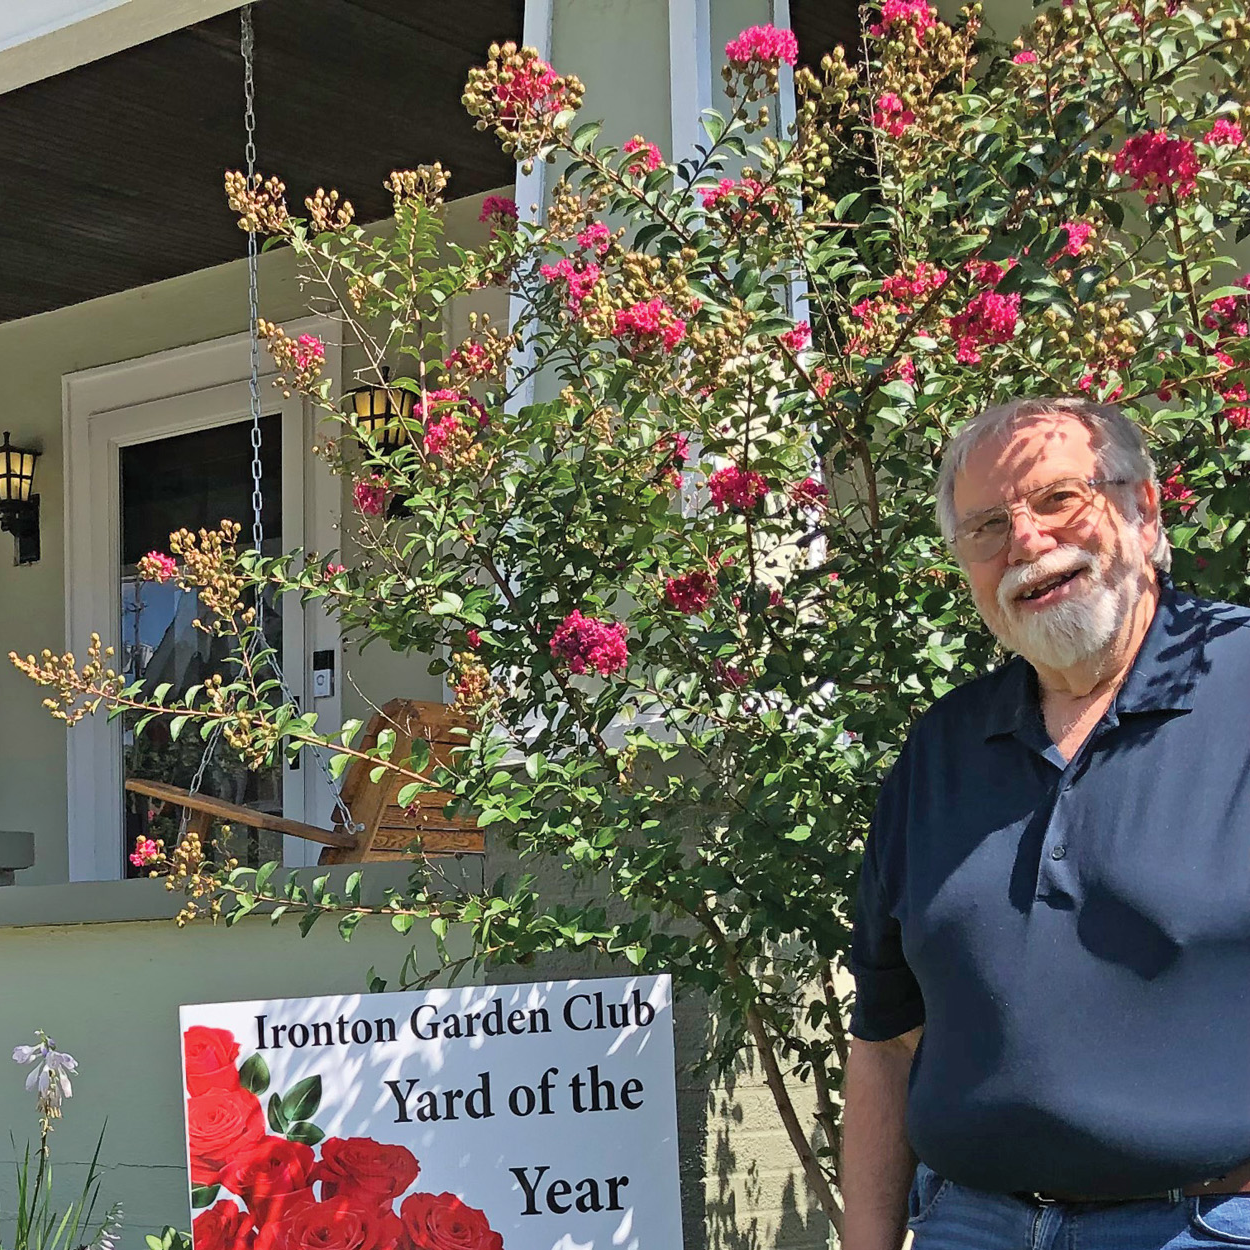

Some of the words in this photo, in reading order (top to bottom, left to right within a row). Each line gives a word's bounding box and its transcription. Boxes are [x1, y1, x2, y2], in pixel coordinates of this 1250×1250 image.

[255, 1014, 397, 1050] Ironton
[410, 998, 552, 1041] Garden
[563, 988, 656, 1031] Club
[384, 1071, 496, 1124] Yard
[508, 1067, 559, 1117] of
[568, 1064, 644, 1114] the
[508, 1165, 629, 1216] Year
